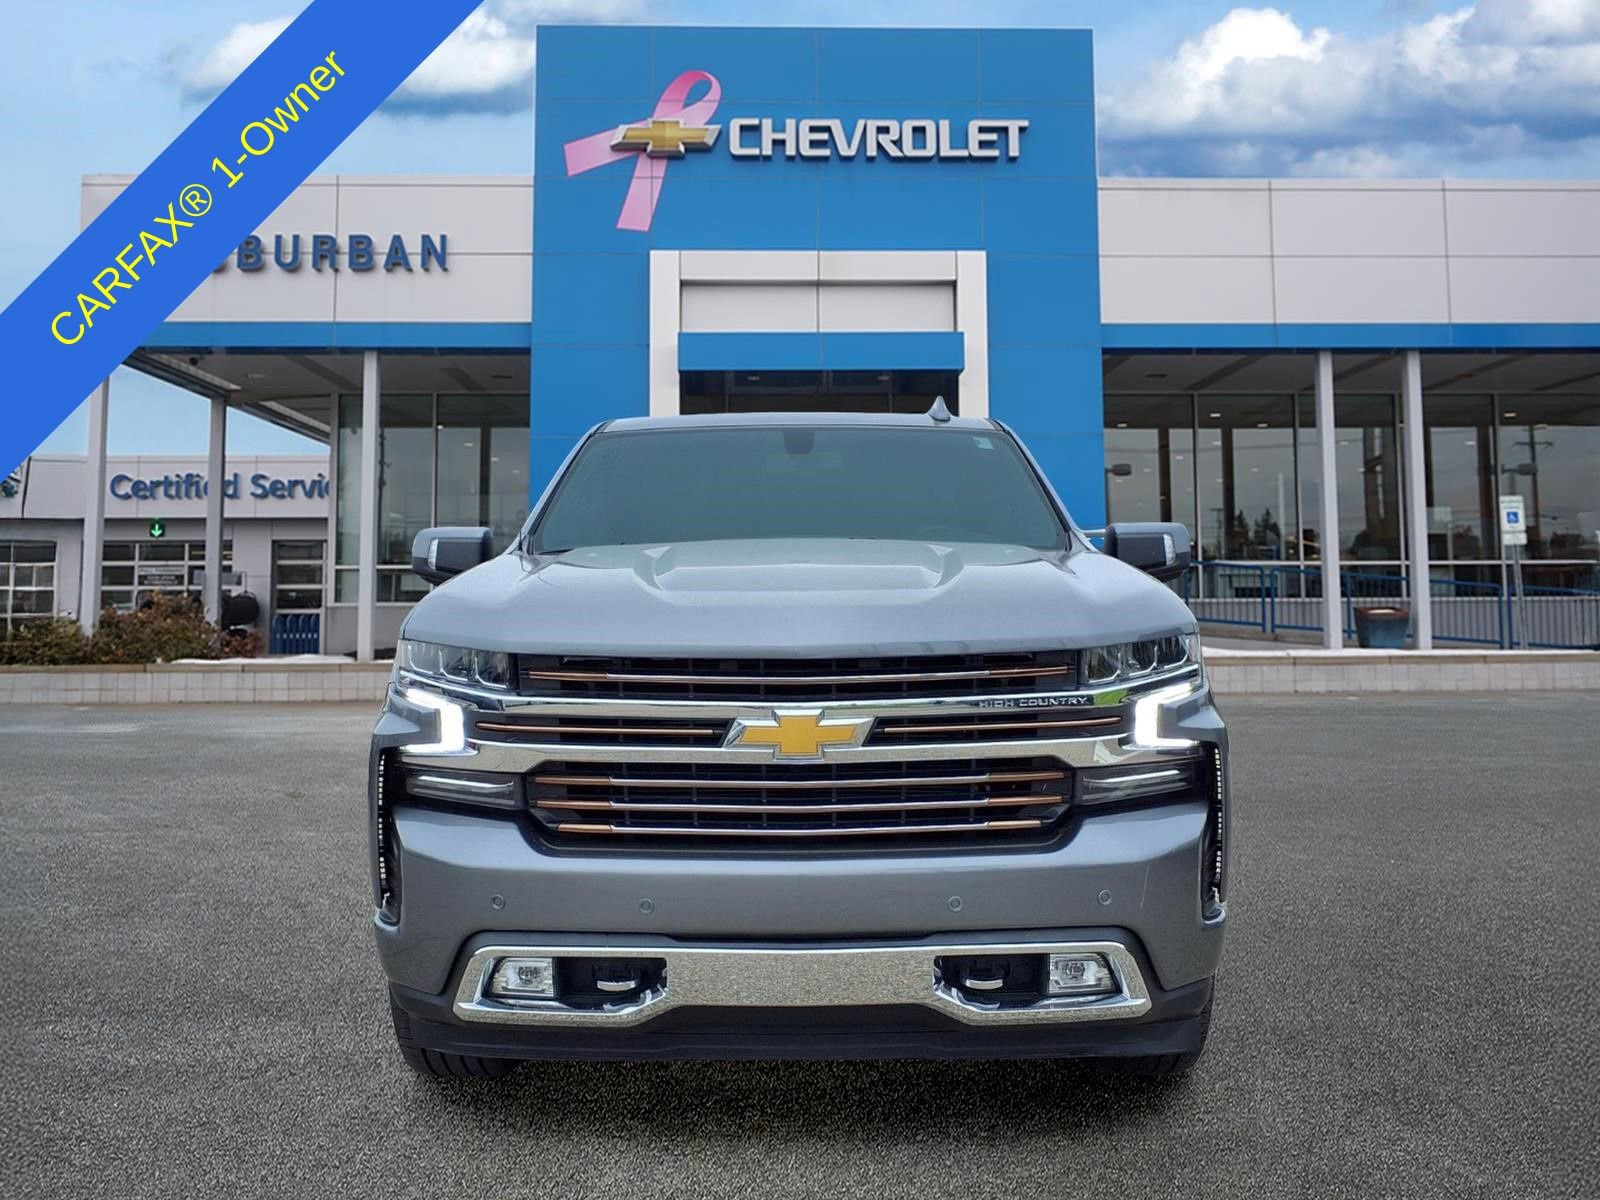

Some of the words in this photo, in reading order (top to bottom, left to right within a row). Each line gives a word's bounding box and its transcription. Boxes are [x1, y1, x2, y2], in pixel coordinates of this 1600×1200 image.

[729, 118, 1029, 157] CHEVROLET
[213, 234, 449, 272] BURBAN
[110, 472, 240, 500] Certifid
[1019, 696, 1088, 707] COUNTRY
